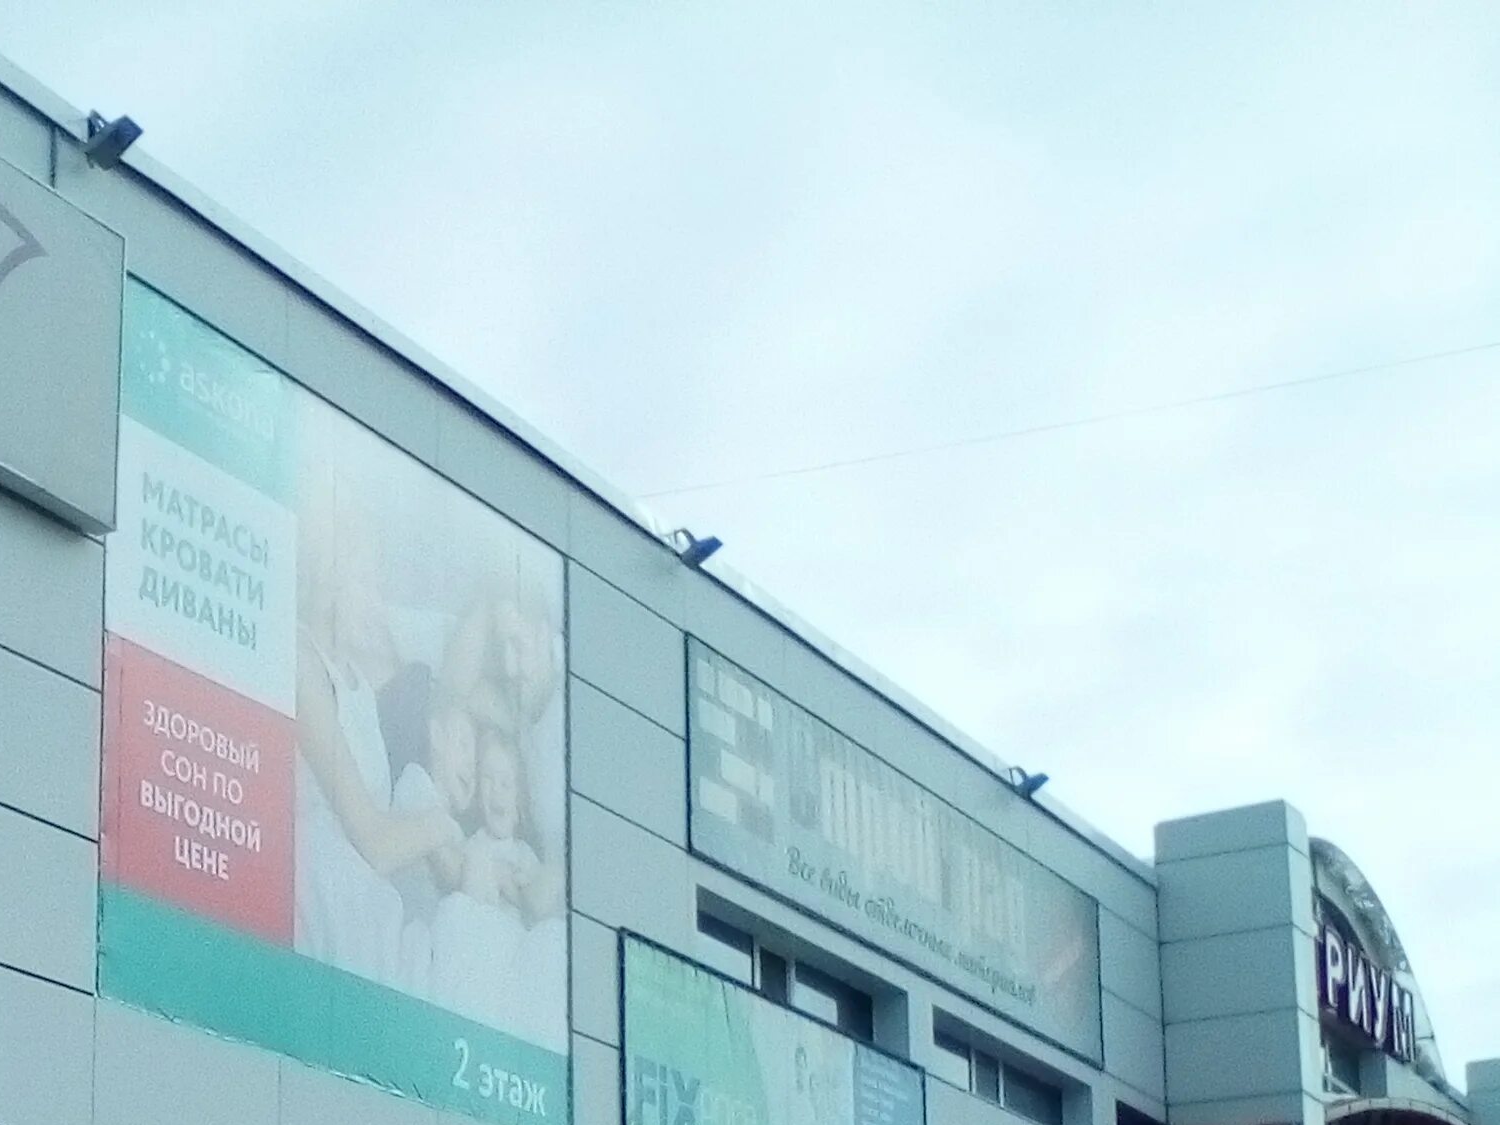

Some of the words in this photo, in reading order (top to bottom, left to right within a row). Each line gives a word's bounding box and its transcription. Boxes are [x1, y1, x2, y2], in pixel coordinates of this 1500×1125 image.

[142, 471, 269, 569] МАТРАСЫ
[139, 518, 265, 610] КРОВАТИ
[139, 565, 257, 651] ДИВАНЫ
[143, 700, 260, 774] ЗДОРОВЫЙ
[160, 749, 207, 789] СОН
[212, 773, 243, 805] ПО
[140, 780, 261, 853] ВЫГОДНОЙ
[173, 836, 230, 881] ЦЕНЕ
[451, 1038, 469, 1089] 2
[478, 1062, 546, 1117] этаж
